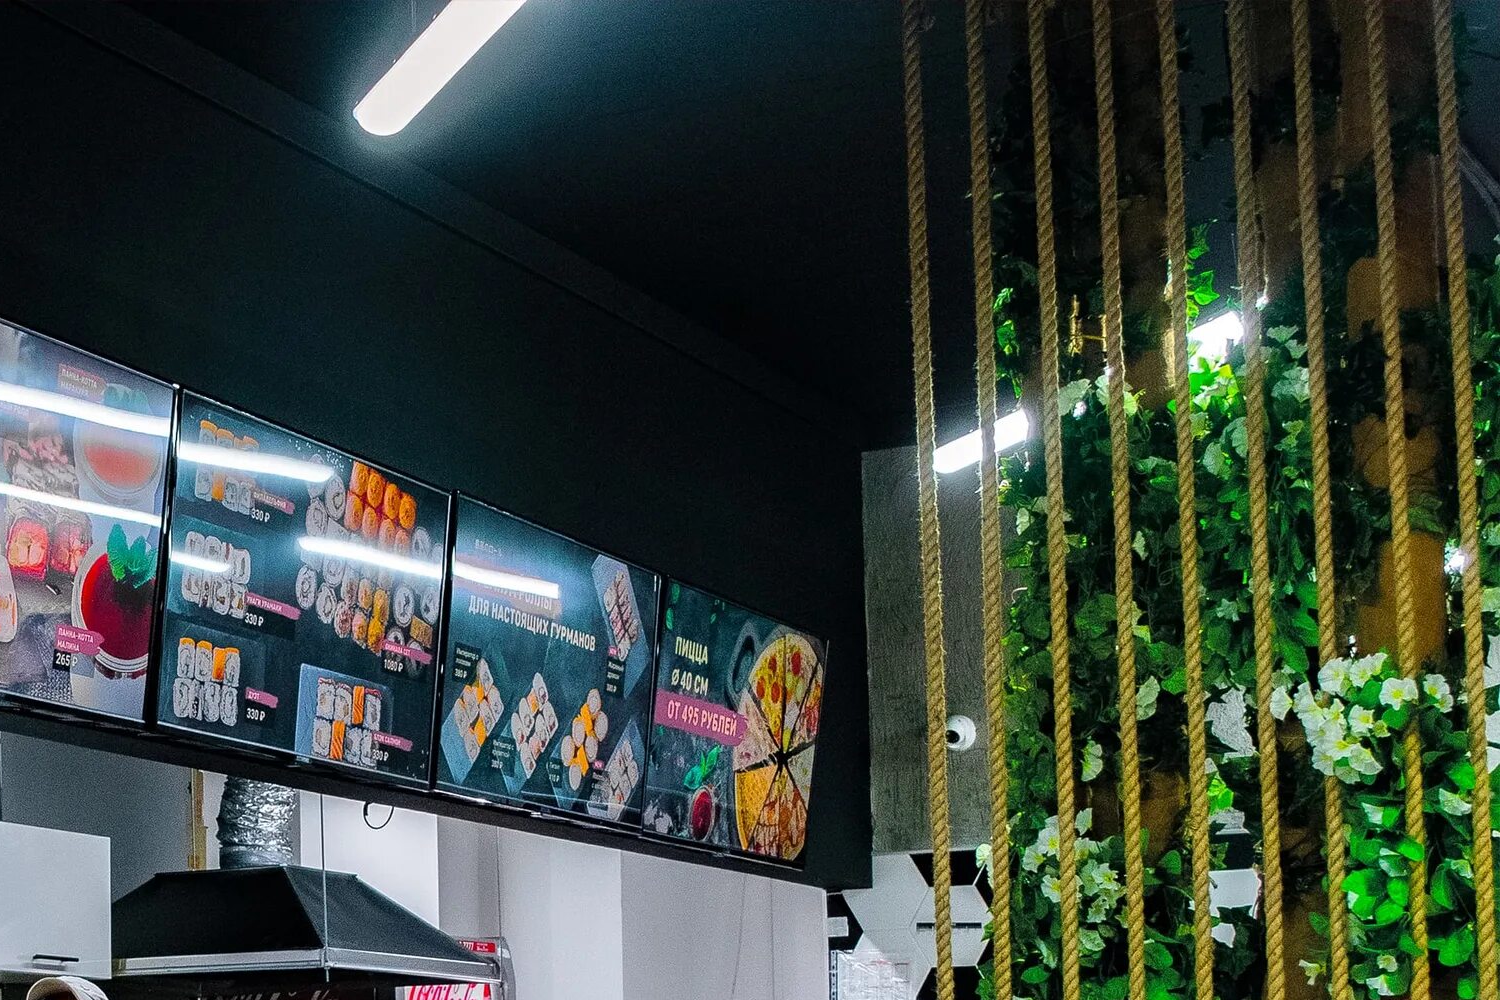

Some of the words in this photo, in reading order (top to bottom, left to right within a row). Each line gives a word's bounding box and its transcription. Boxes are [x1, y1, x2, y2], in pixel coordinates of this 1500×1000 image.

[468, 595, 489, 617] ДЛЯ
[491, 602, 549, 636] НАСТОЯЩИХ
[550, 622, 596, 652] ГУРМАНОВ
[55, 652, 71, 667] 265
[675, 635, 709, 665] ПИЦЦА
[680, 673, 691, 690] 40
[694, 678, 709, 696] СМ
[667, 700, 680, 720] ОТ
[682, 704, 699, 726] 495
[700, 708, 738, 737] РУБЛЕЙ
